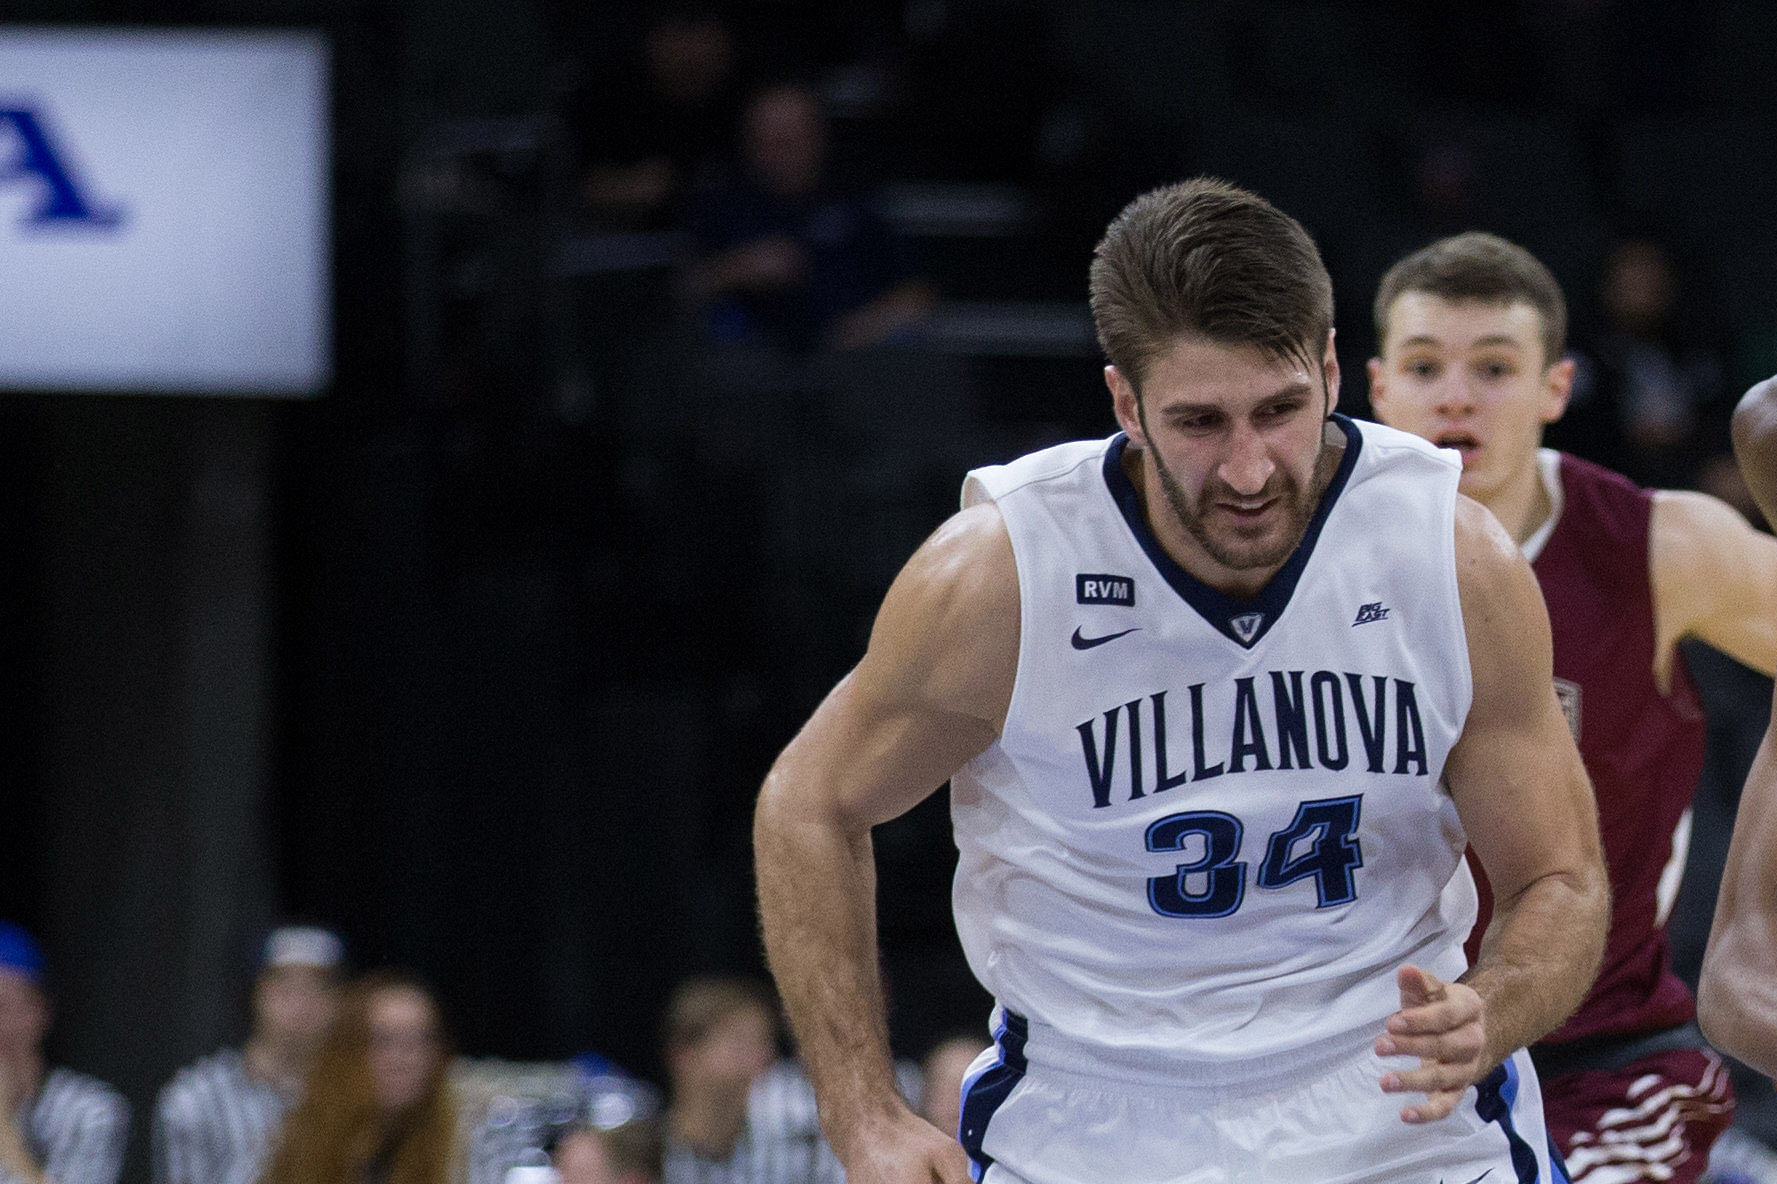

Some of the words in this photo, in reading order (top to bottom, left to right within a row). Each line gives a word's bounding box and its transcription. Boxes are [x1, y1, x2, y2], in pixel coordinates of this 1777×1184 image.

[1084, 580, 1128, 599] RVM
[1076, 670, 1429, 809] VILLANOVA
[1145, 793, 1364, 919] 34
